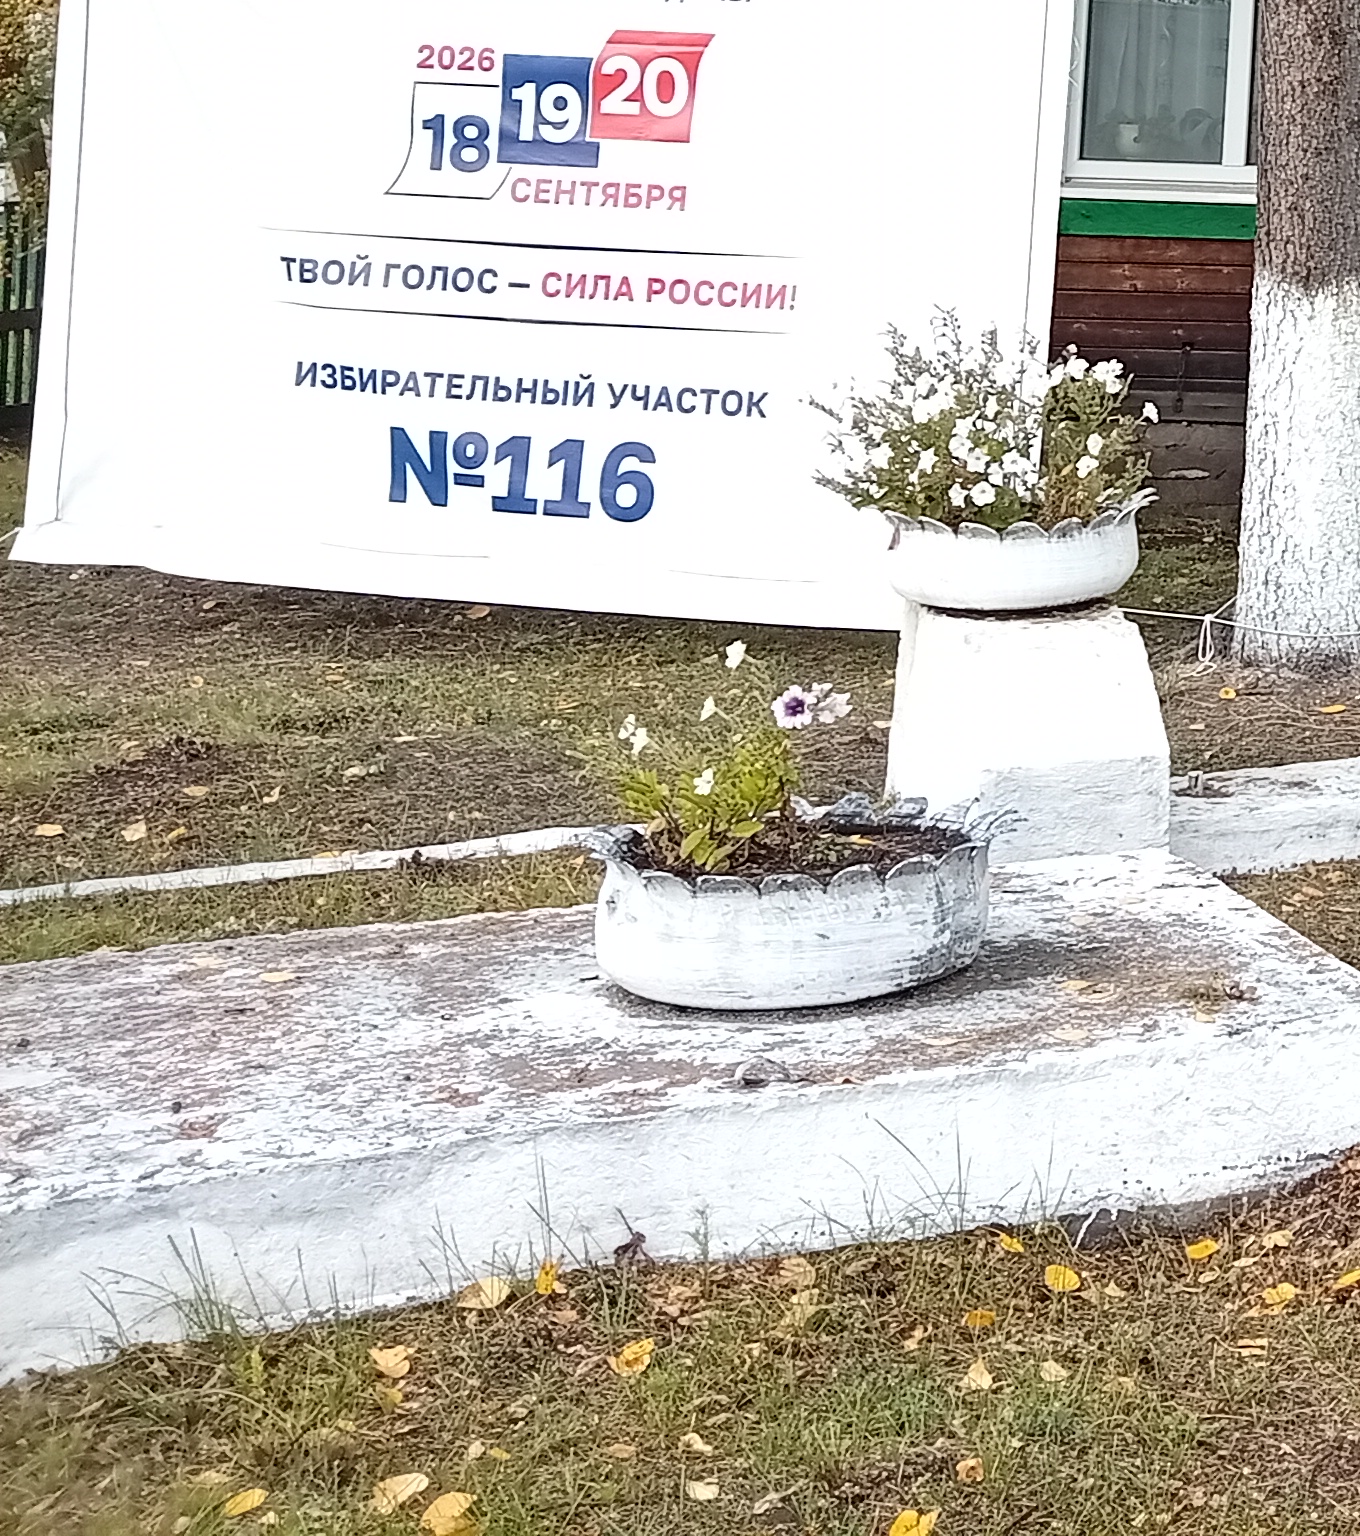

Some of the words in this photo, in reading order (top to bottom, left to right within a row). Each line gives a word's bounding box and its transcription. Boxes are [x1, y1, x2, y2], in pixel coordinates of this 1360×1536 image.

[416, 44, 496, 72] 2026
[421, 113, 491, 173] 18
[510, 80, 583, 145] 19
[599, 52, 690, 119] 20
[510, 177, 688, 212] СЕНТЯБРЯ
[279, 254, 372, 288] ТВОЙ
[381, 262, 499, 294] ГОЛОС
[540, 271, 635, 302] СИЛА
[645, 277, 797, 311] РОССИИ!
[293, 360, 596, 408] ИЗБИРАТЕЛЬНЫЙ
[606, 381, 769, 419] УЧАСТОК
[387, 425, 657, 523] №116
